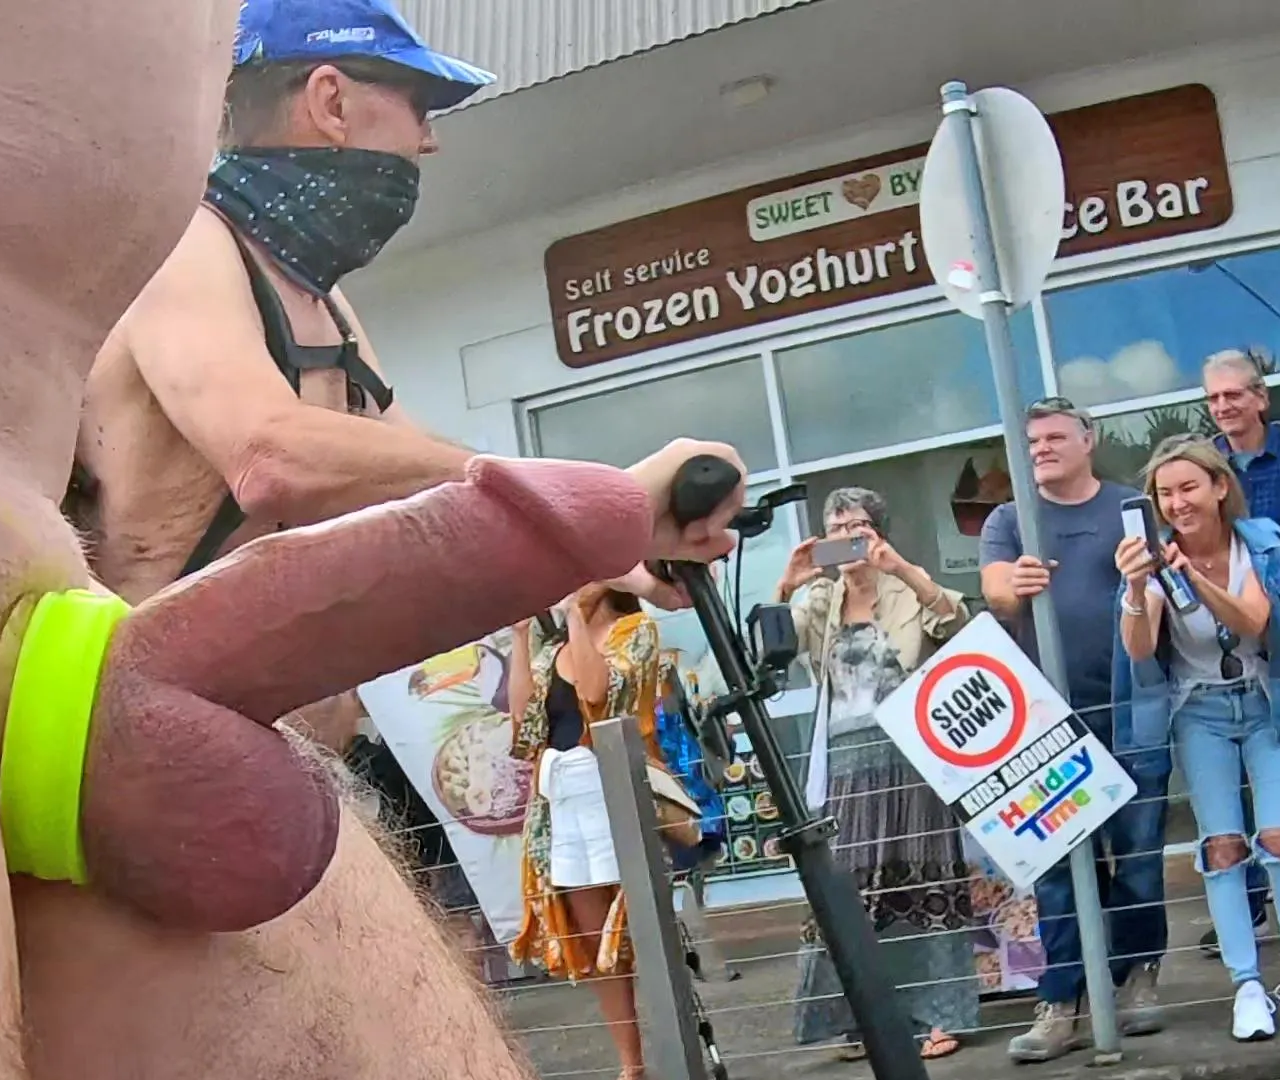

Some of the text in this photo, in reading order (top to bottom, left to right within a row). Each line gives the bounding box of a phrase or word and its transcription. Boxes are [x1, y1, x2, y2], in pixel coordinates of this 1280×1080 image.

[755, 191, 833, 229] SWEET
[565, 248, 710, 301] Self service
[567, 285, 719, 353] Frozen
[726, 231, 919, 310] Yoghurt
[1116, 176, 1209, 228] Bar
[931, 669, 992, 730] SLOW
[947, 691, 1007, 749] DOWN
[960, 721, 1078, 817] KIDS AROUND!
[998, 745, 1093, 829] Holiday
[1014, 788, 1092, 842] Time
